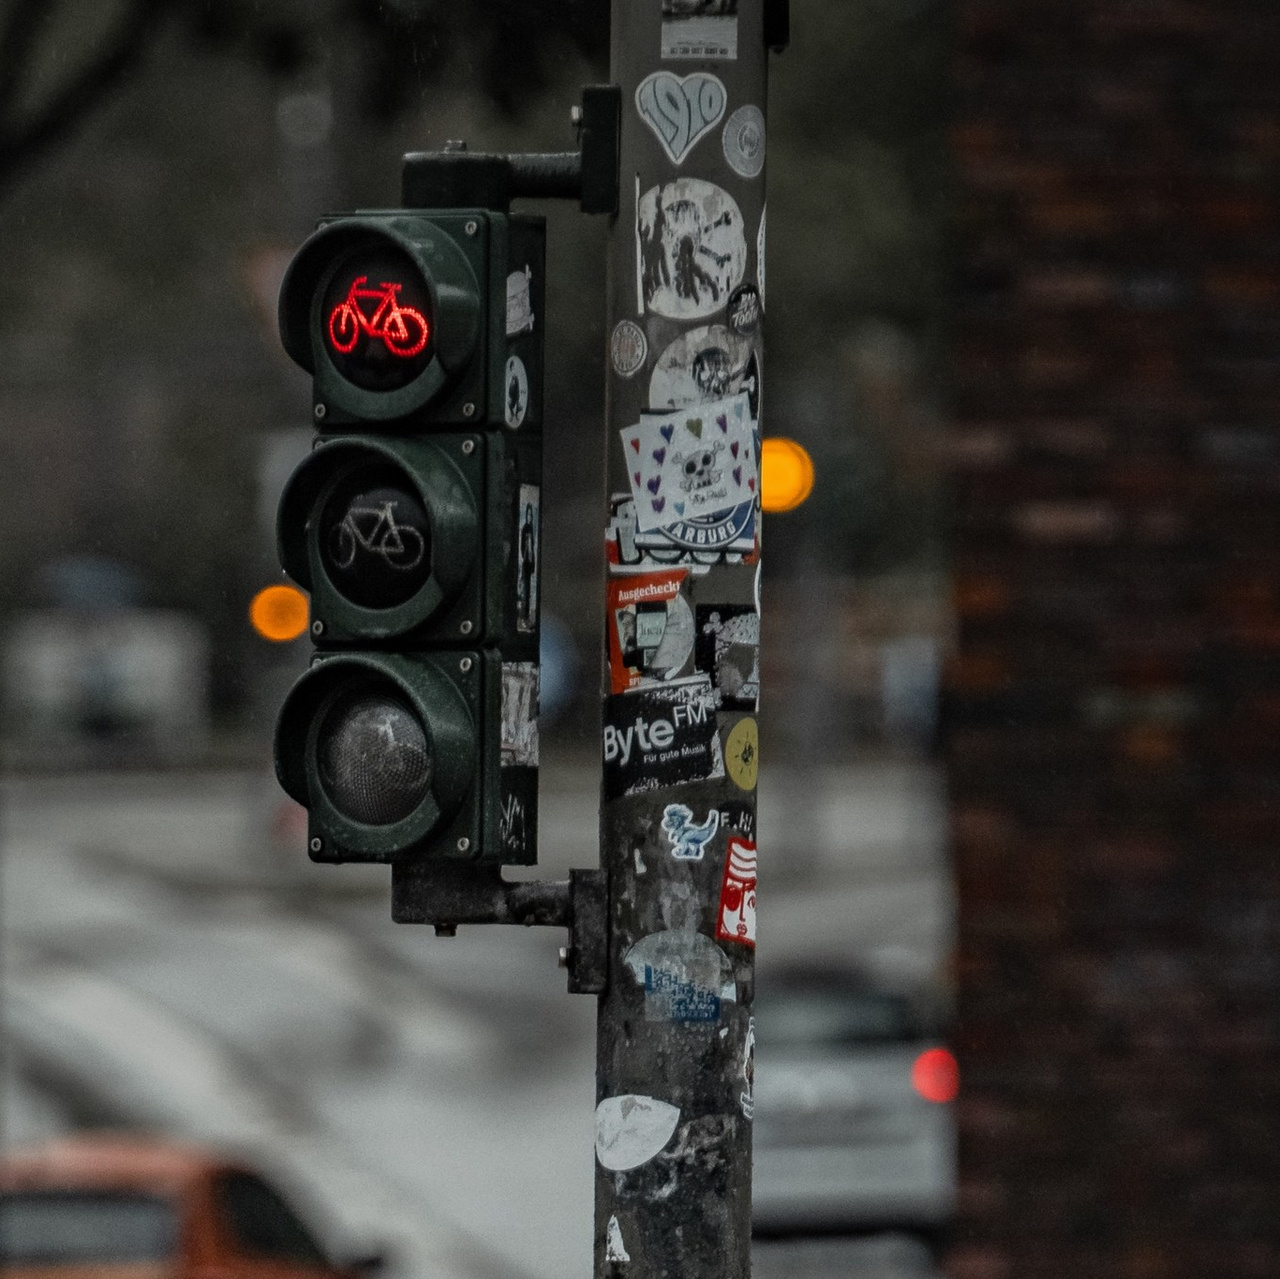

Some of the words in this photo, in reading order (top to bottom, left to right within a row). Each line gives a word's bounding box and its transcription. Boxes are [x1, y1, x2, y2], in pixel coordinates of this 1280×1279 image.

[663, 520, 736, 545] ARBURG
[604, 717, 674, 767] Byte
[673, 703, 707, 728] FM
[643, 754, 658, 764] Für
[659, 750, 680, 762] gute
[681, 744, 706, 756] Musik
